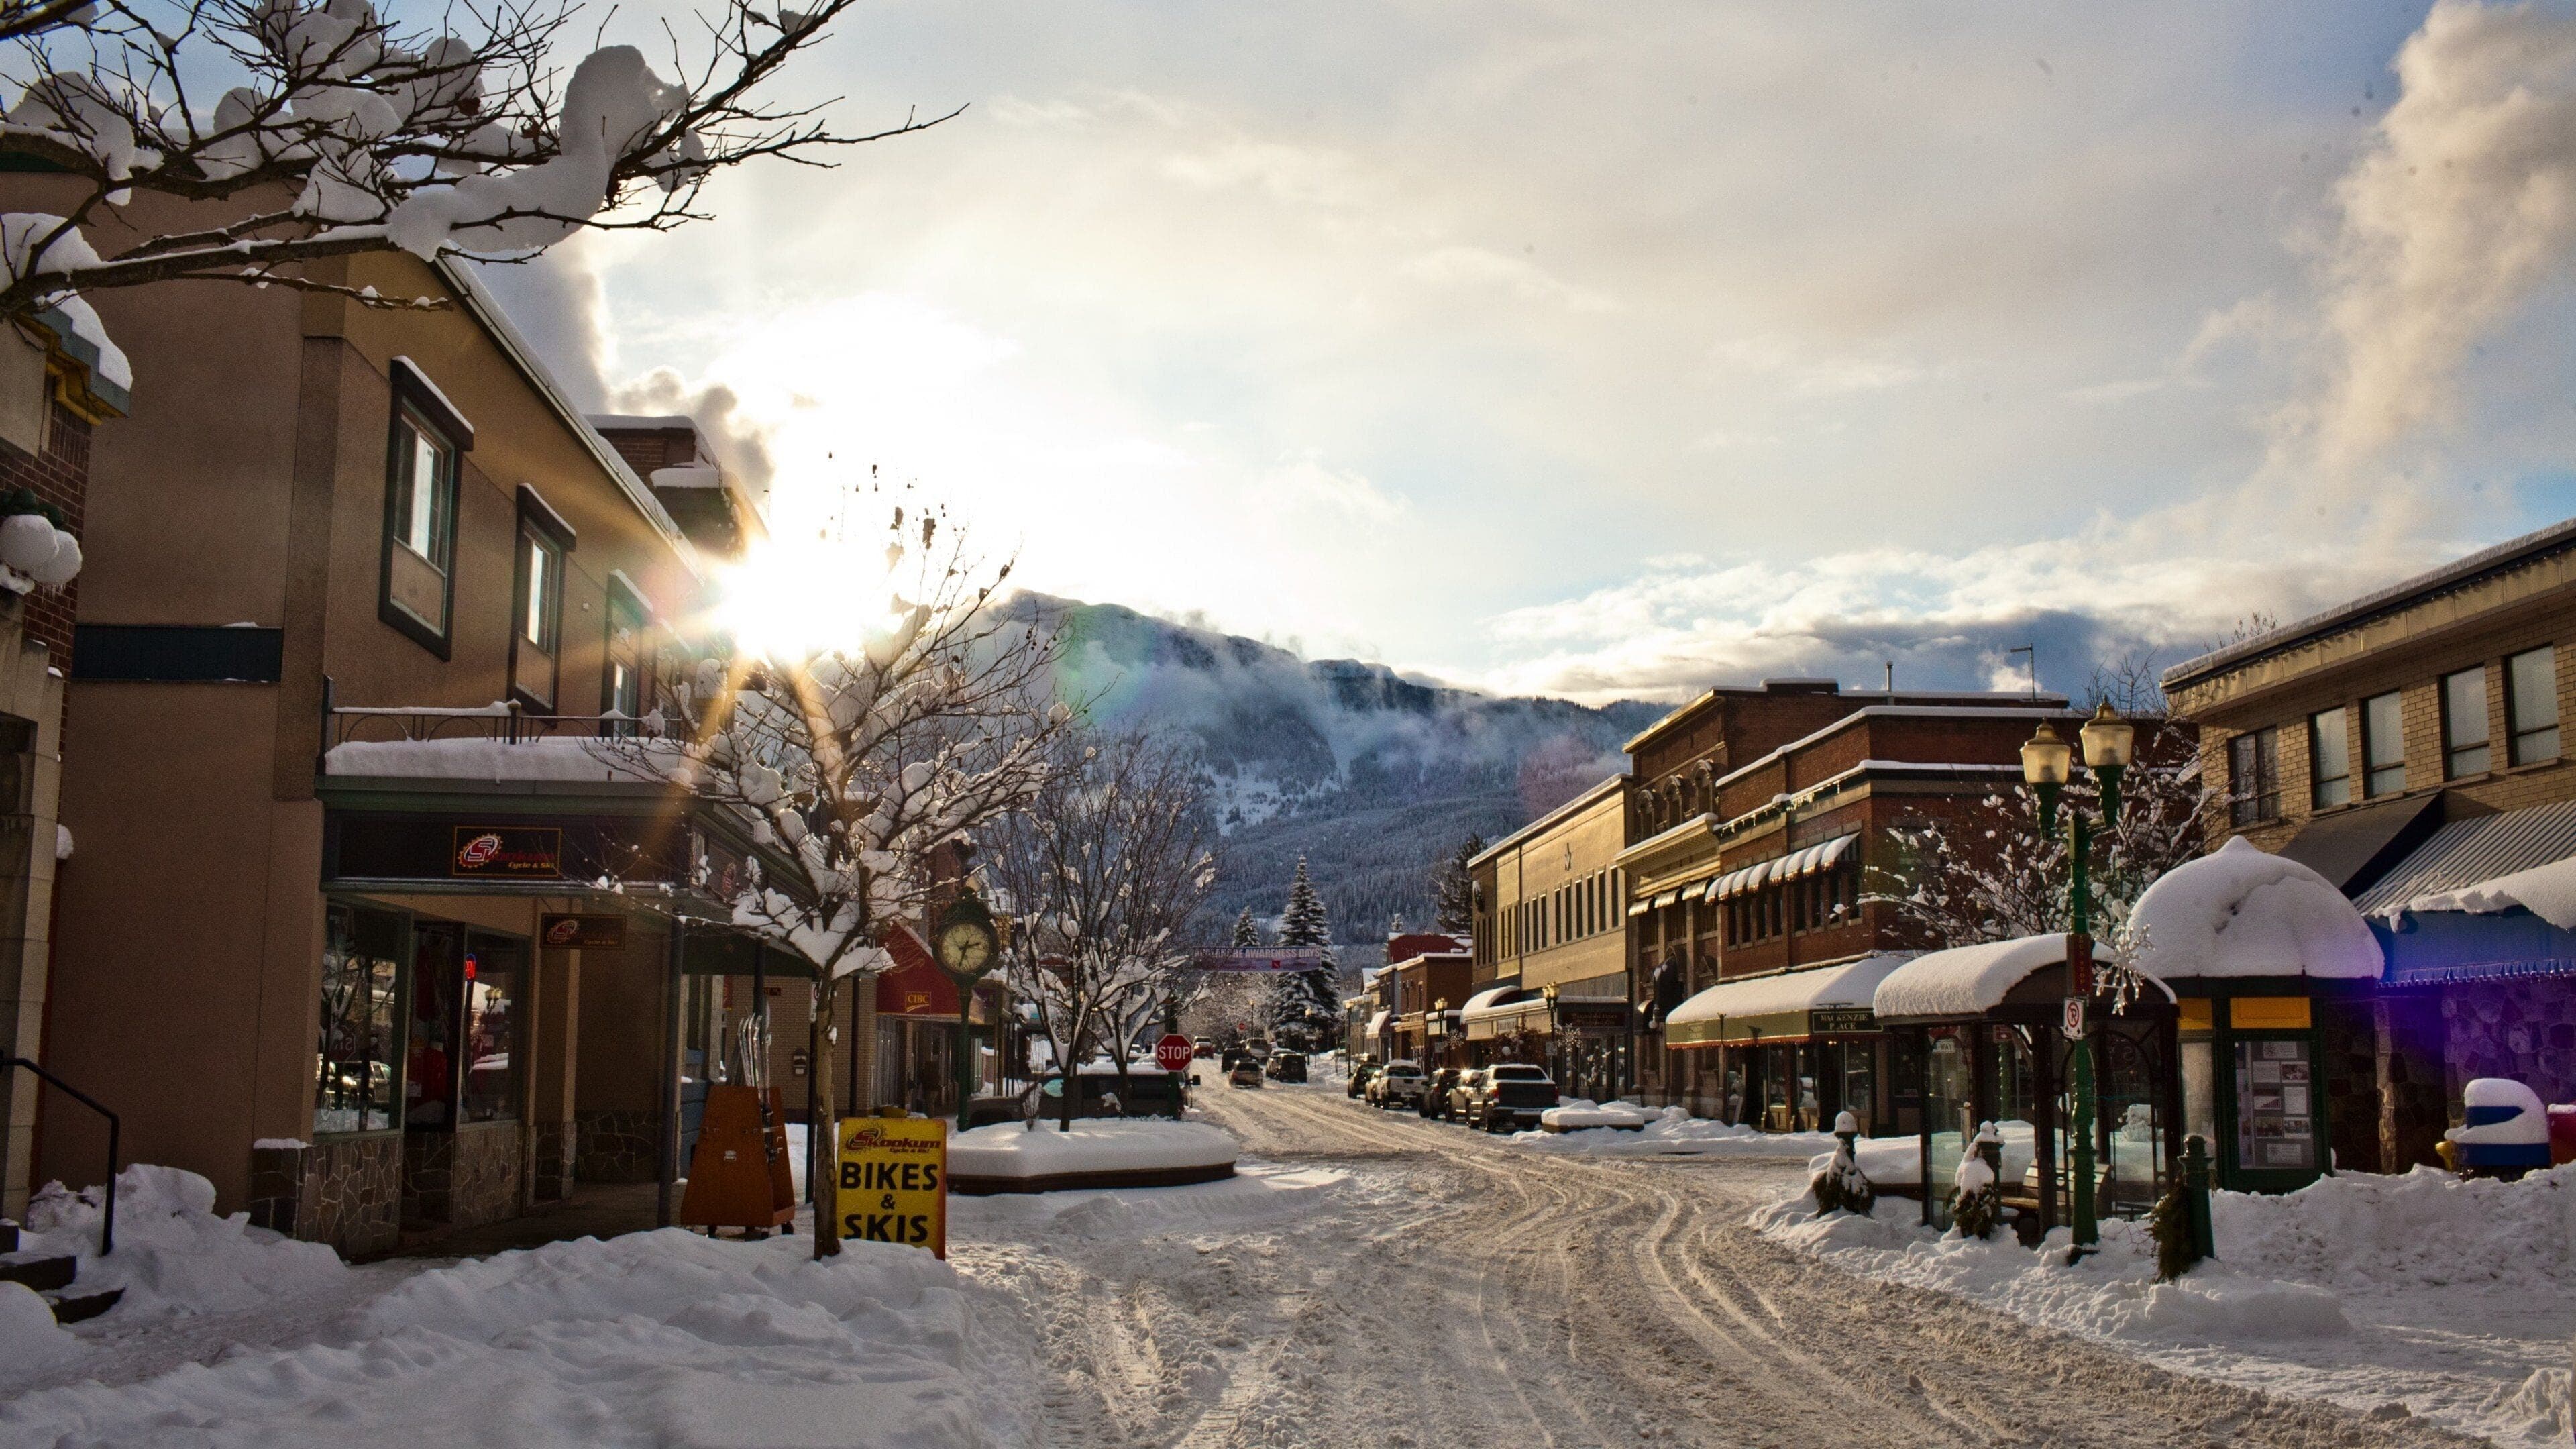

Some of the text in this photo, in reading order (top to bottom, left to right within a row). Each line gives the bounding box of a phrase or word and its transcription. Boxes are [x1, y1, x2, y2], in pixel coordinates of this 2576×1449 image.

[1194, 948, 1320, 959] AANCHE AWARENESS DAYS
[907, 994, 929, 1004] CIBC
[1158, 1046, 1191, 1060] STOP
[846, 1128, 941, 1150] Skookum
[840, 1161, 938, 1191] BIKES
[881, 1193, 896, 1210] &
[843, 1214, 928, 1242] SKIS
